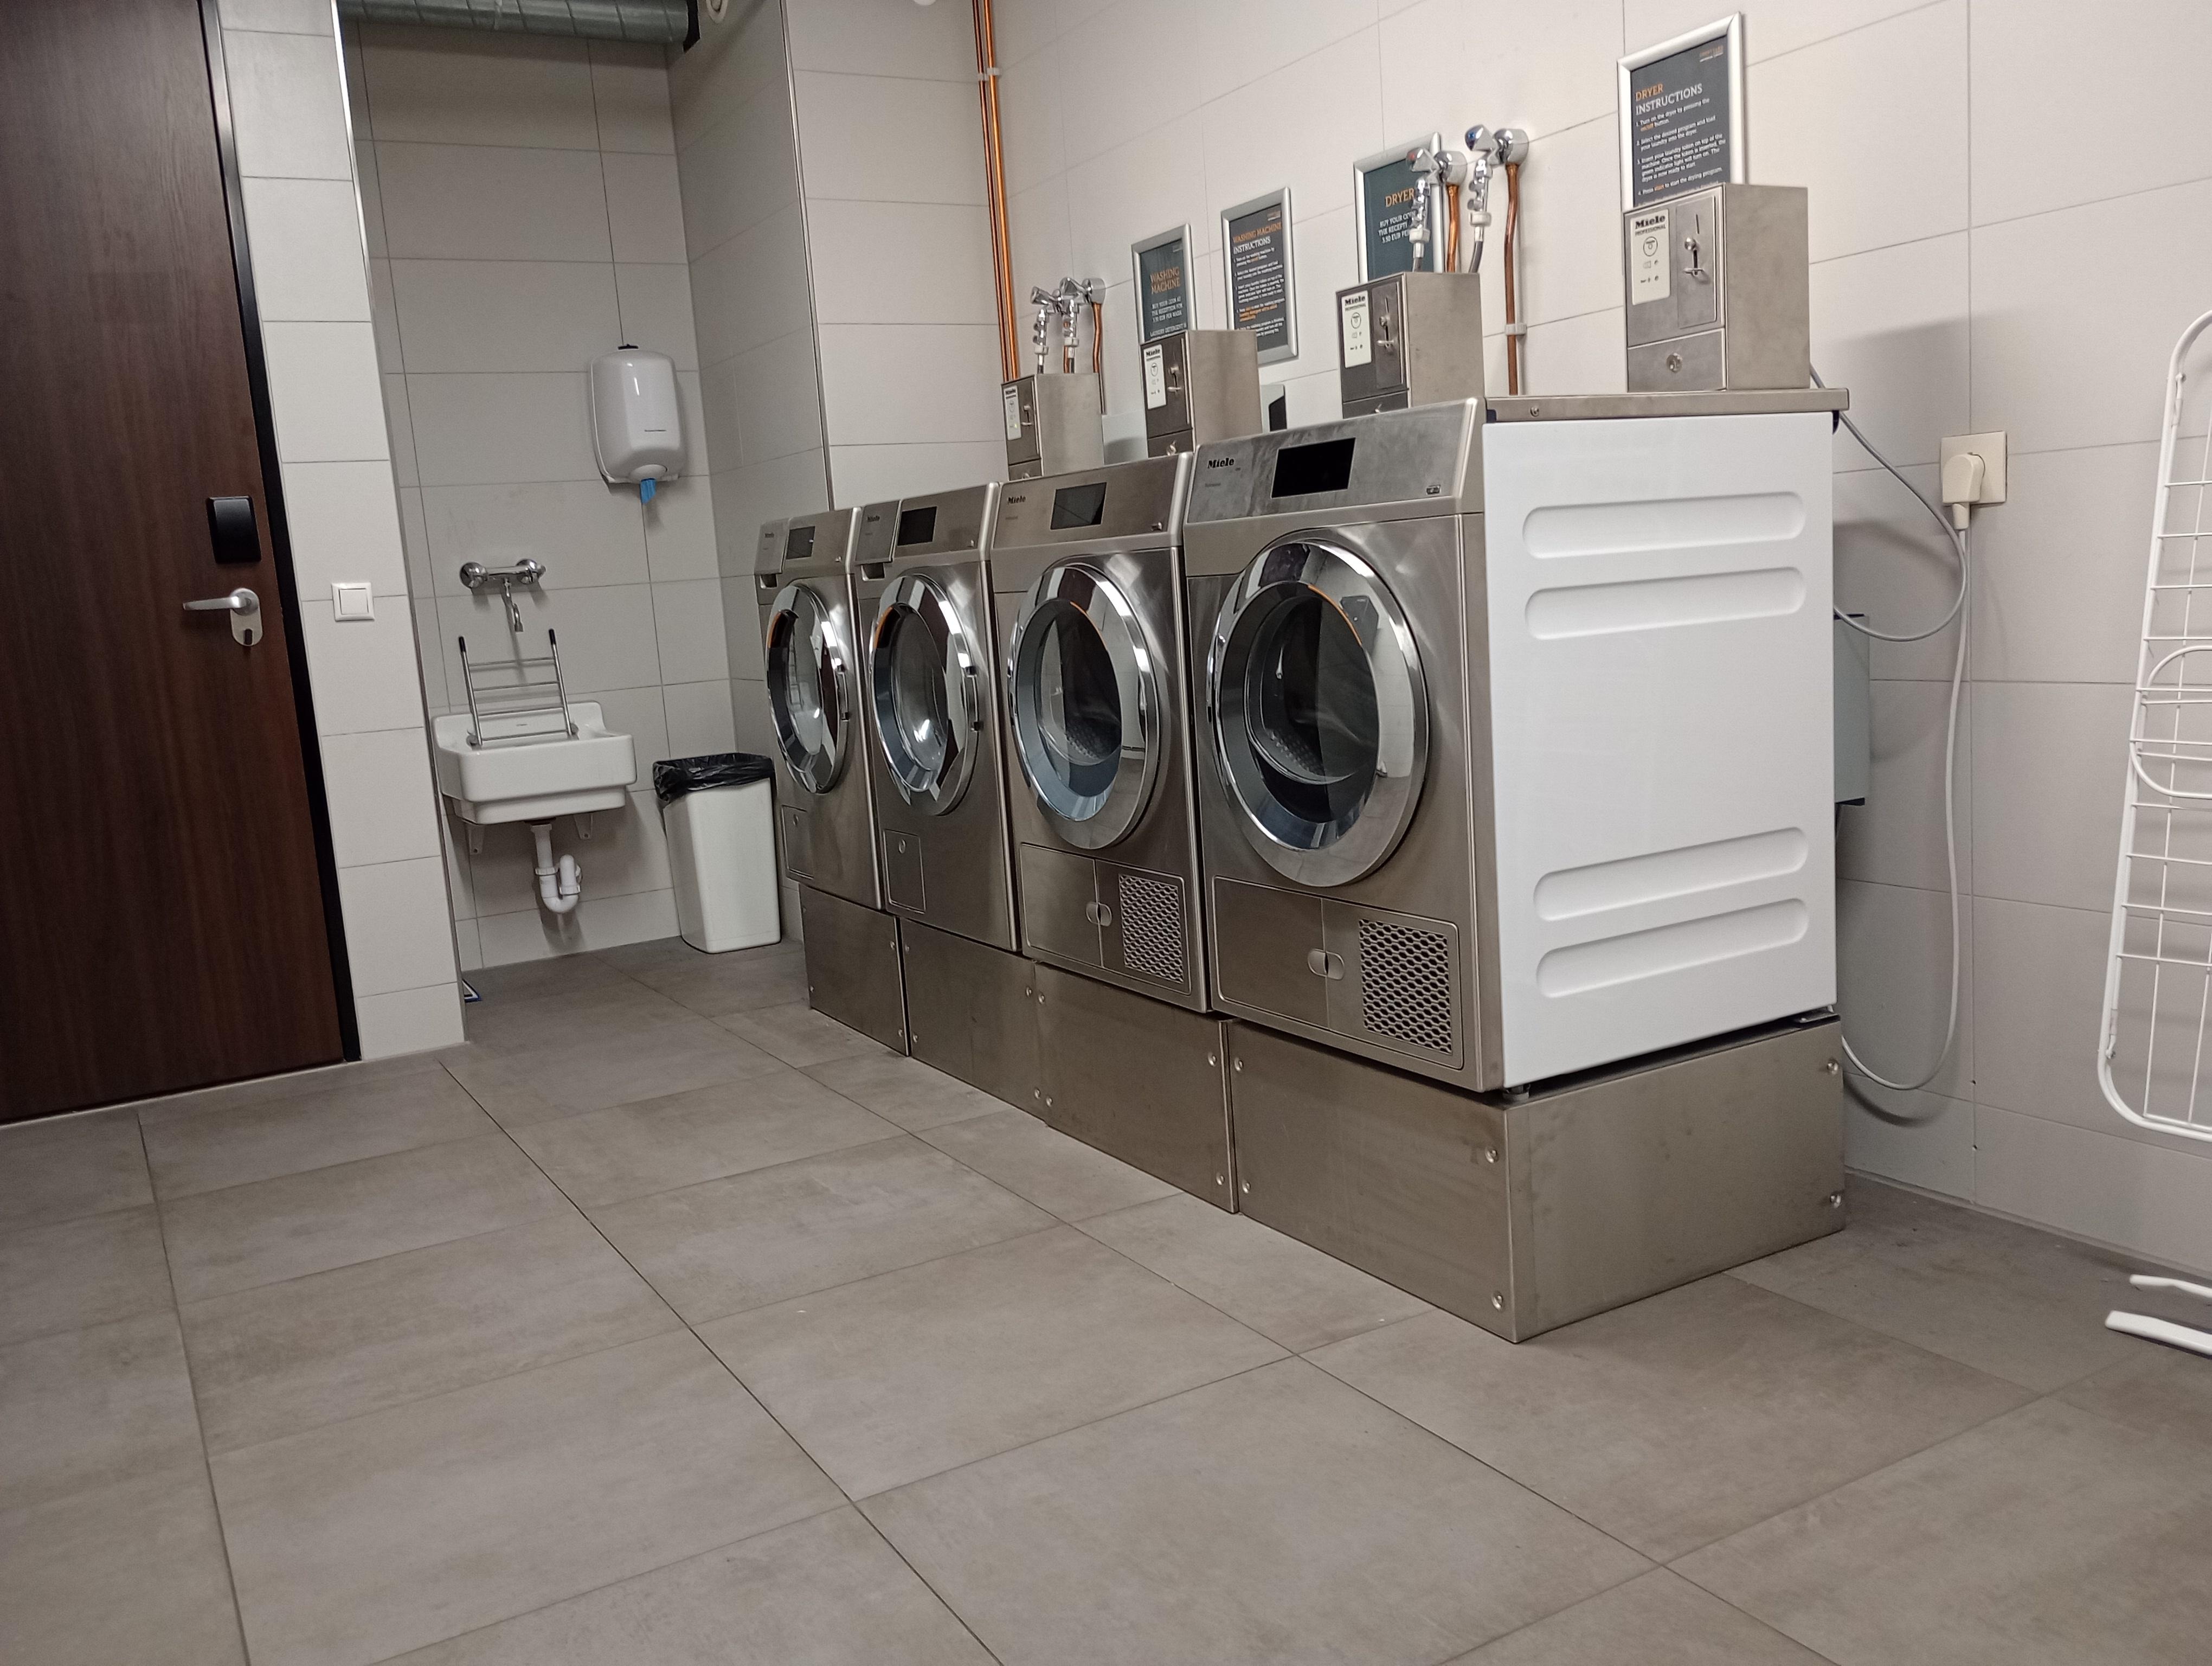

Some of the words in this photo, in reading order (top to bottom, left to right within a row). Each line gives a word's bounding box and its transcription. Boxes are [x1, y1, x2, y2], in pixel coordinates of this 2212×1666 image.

[1636, 84, 1663, 101] DRYER
[1636, 84, 1702, 115] INSTRUCTIONS
[1385, 188, 1414, 208] DRYER
[1390, 215, 1403, 225] YOUR
[1635, 216, 1666, 229] Miele
[1233, 229, 1256, 243] WASHING
[1379, 228, 1388, 236] THE
[1388, 222, 1408, 234] RECEPTI
[1233, 236, 1271, 255] INSTRUCTIONS
[1150, 266, 1180, 283] WASHING
[1150, 277, 1181, 294] MACHINE
[1345, 296, 1366, 306] Miele
[1146, 349, 1161, 357] Miele
[1207, 458, 1234, 469] Miele
[1008, 496, 1026, 505] Miele
